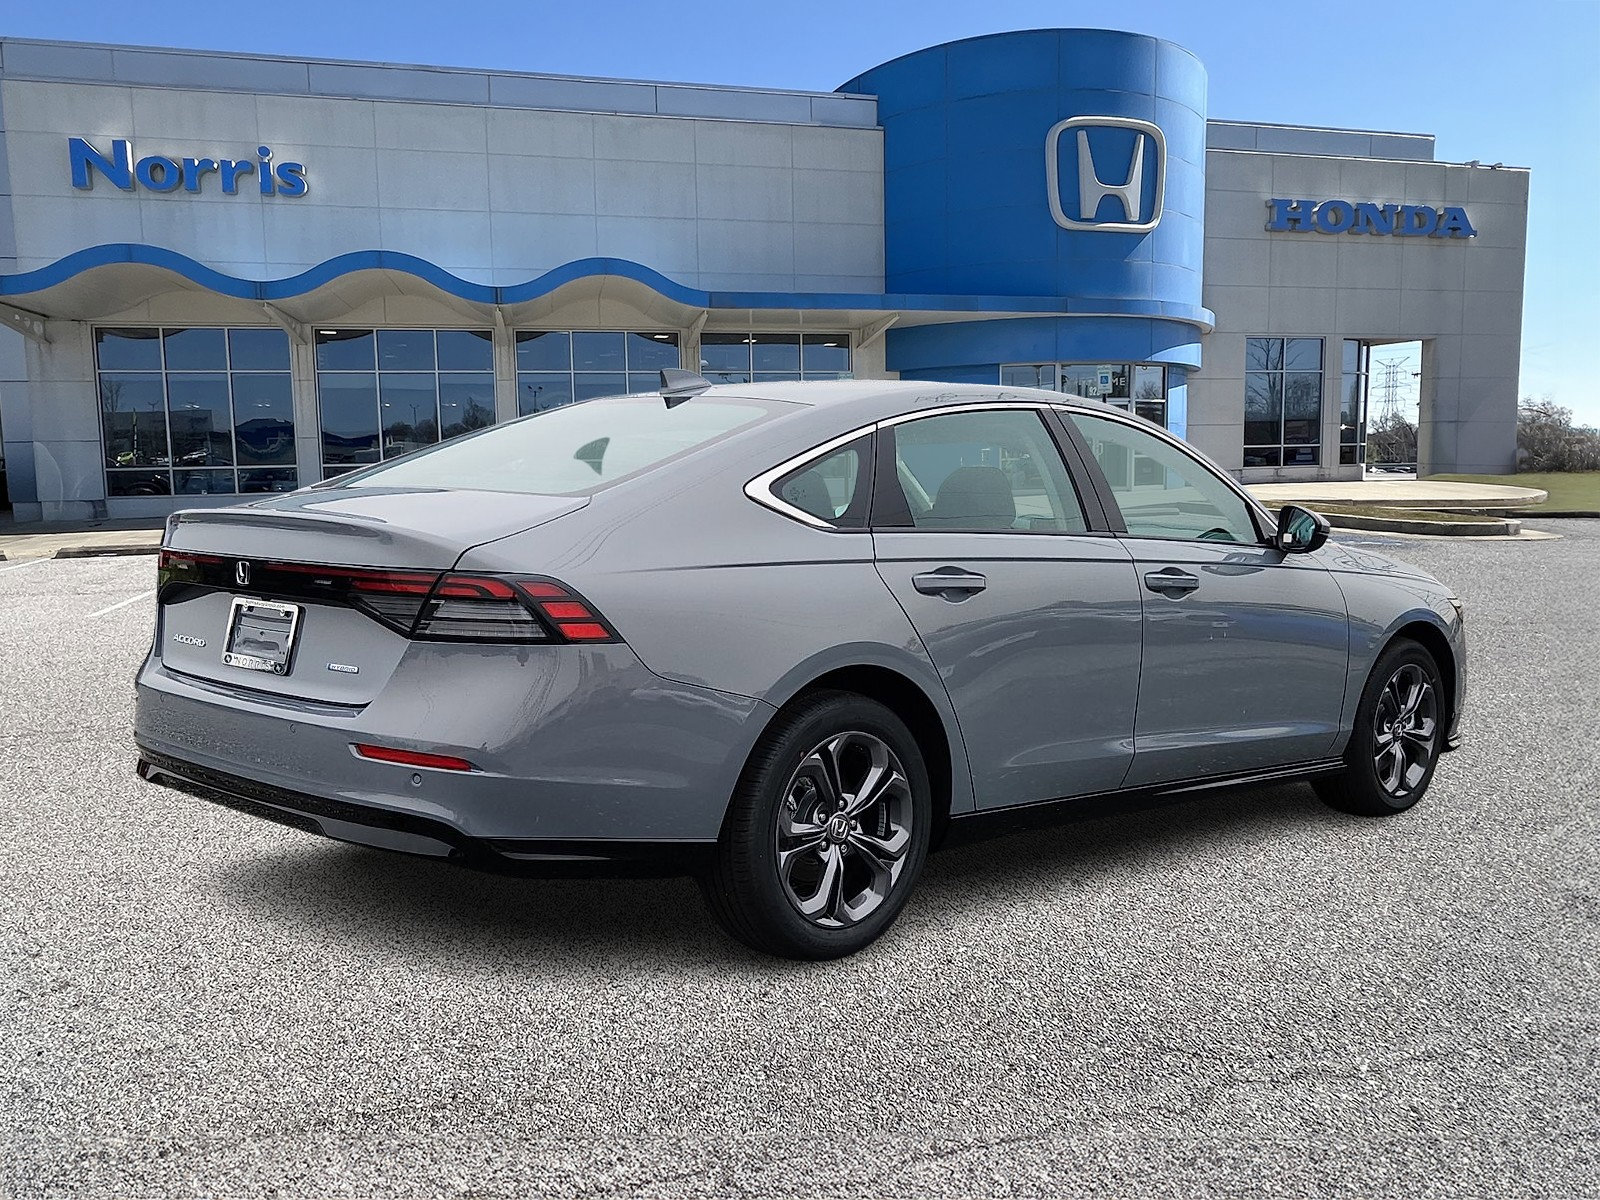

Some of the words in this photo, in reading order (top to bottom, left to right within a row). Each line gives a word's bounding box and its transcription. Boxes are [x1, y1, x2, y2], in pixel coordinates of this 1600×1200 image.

[68, 137, 309, 197] Norris
[1266, 198, 1478, 239] HONDA
[173, 633, 206, 647] ACCORD
